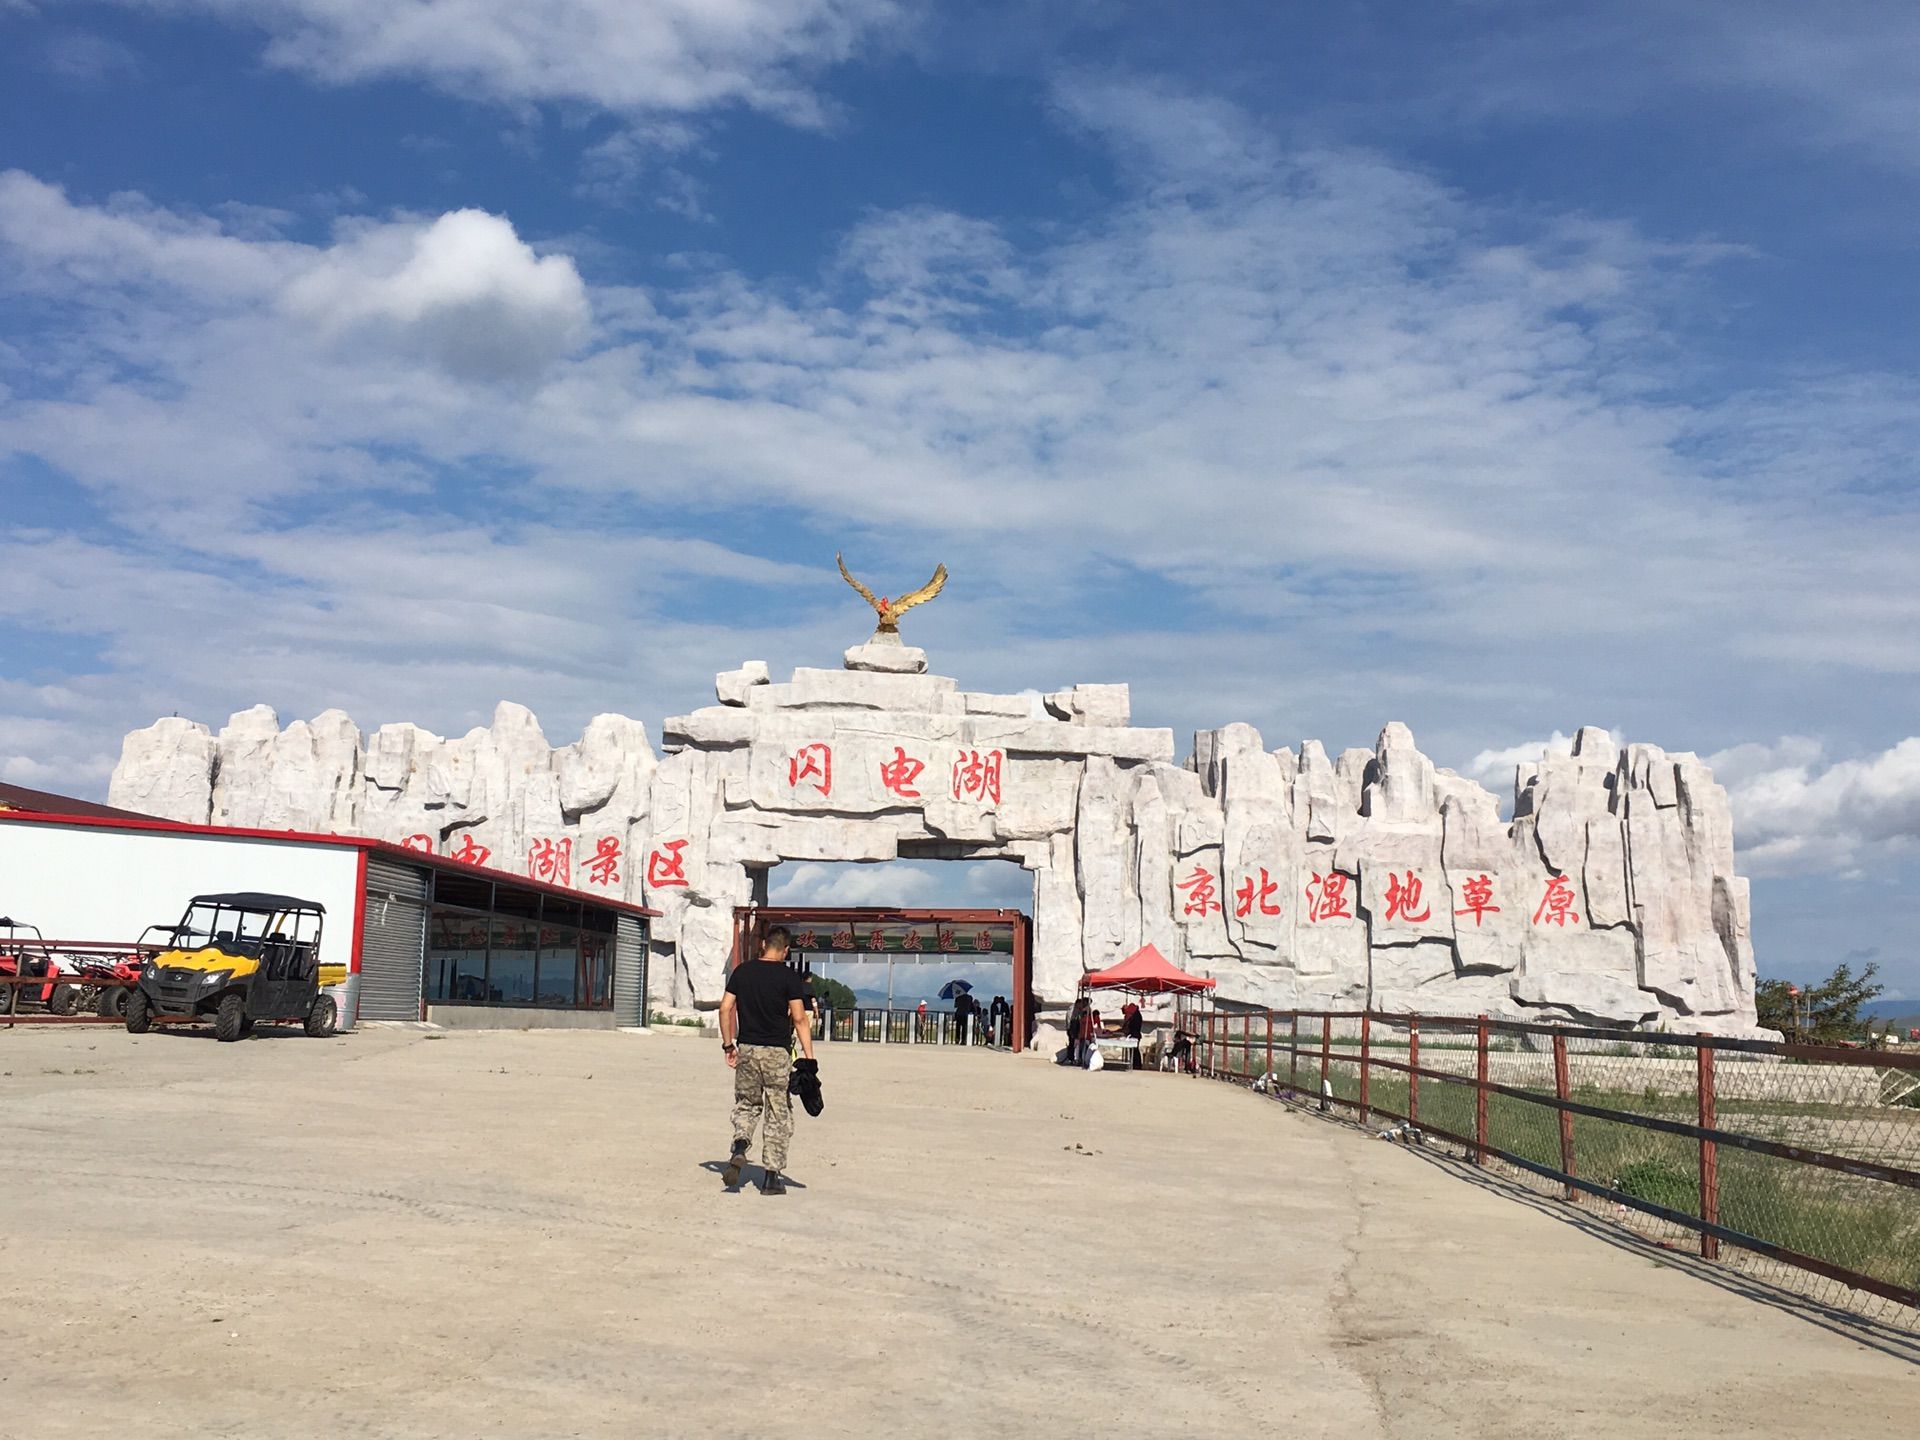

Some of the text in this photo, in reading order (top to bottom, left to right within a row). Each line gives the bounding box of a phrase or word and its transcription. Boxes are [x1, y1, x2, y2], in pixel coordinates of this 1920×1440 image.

[788, 743, 1002, 805] 闪电湖
[1176, 867, 1580, 927] 京北湿地草原
[796, 929, 994, 951] 欢迎再次光临
